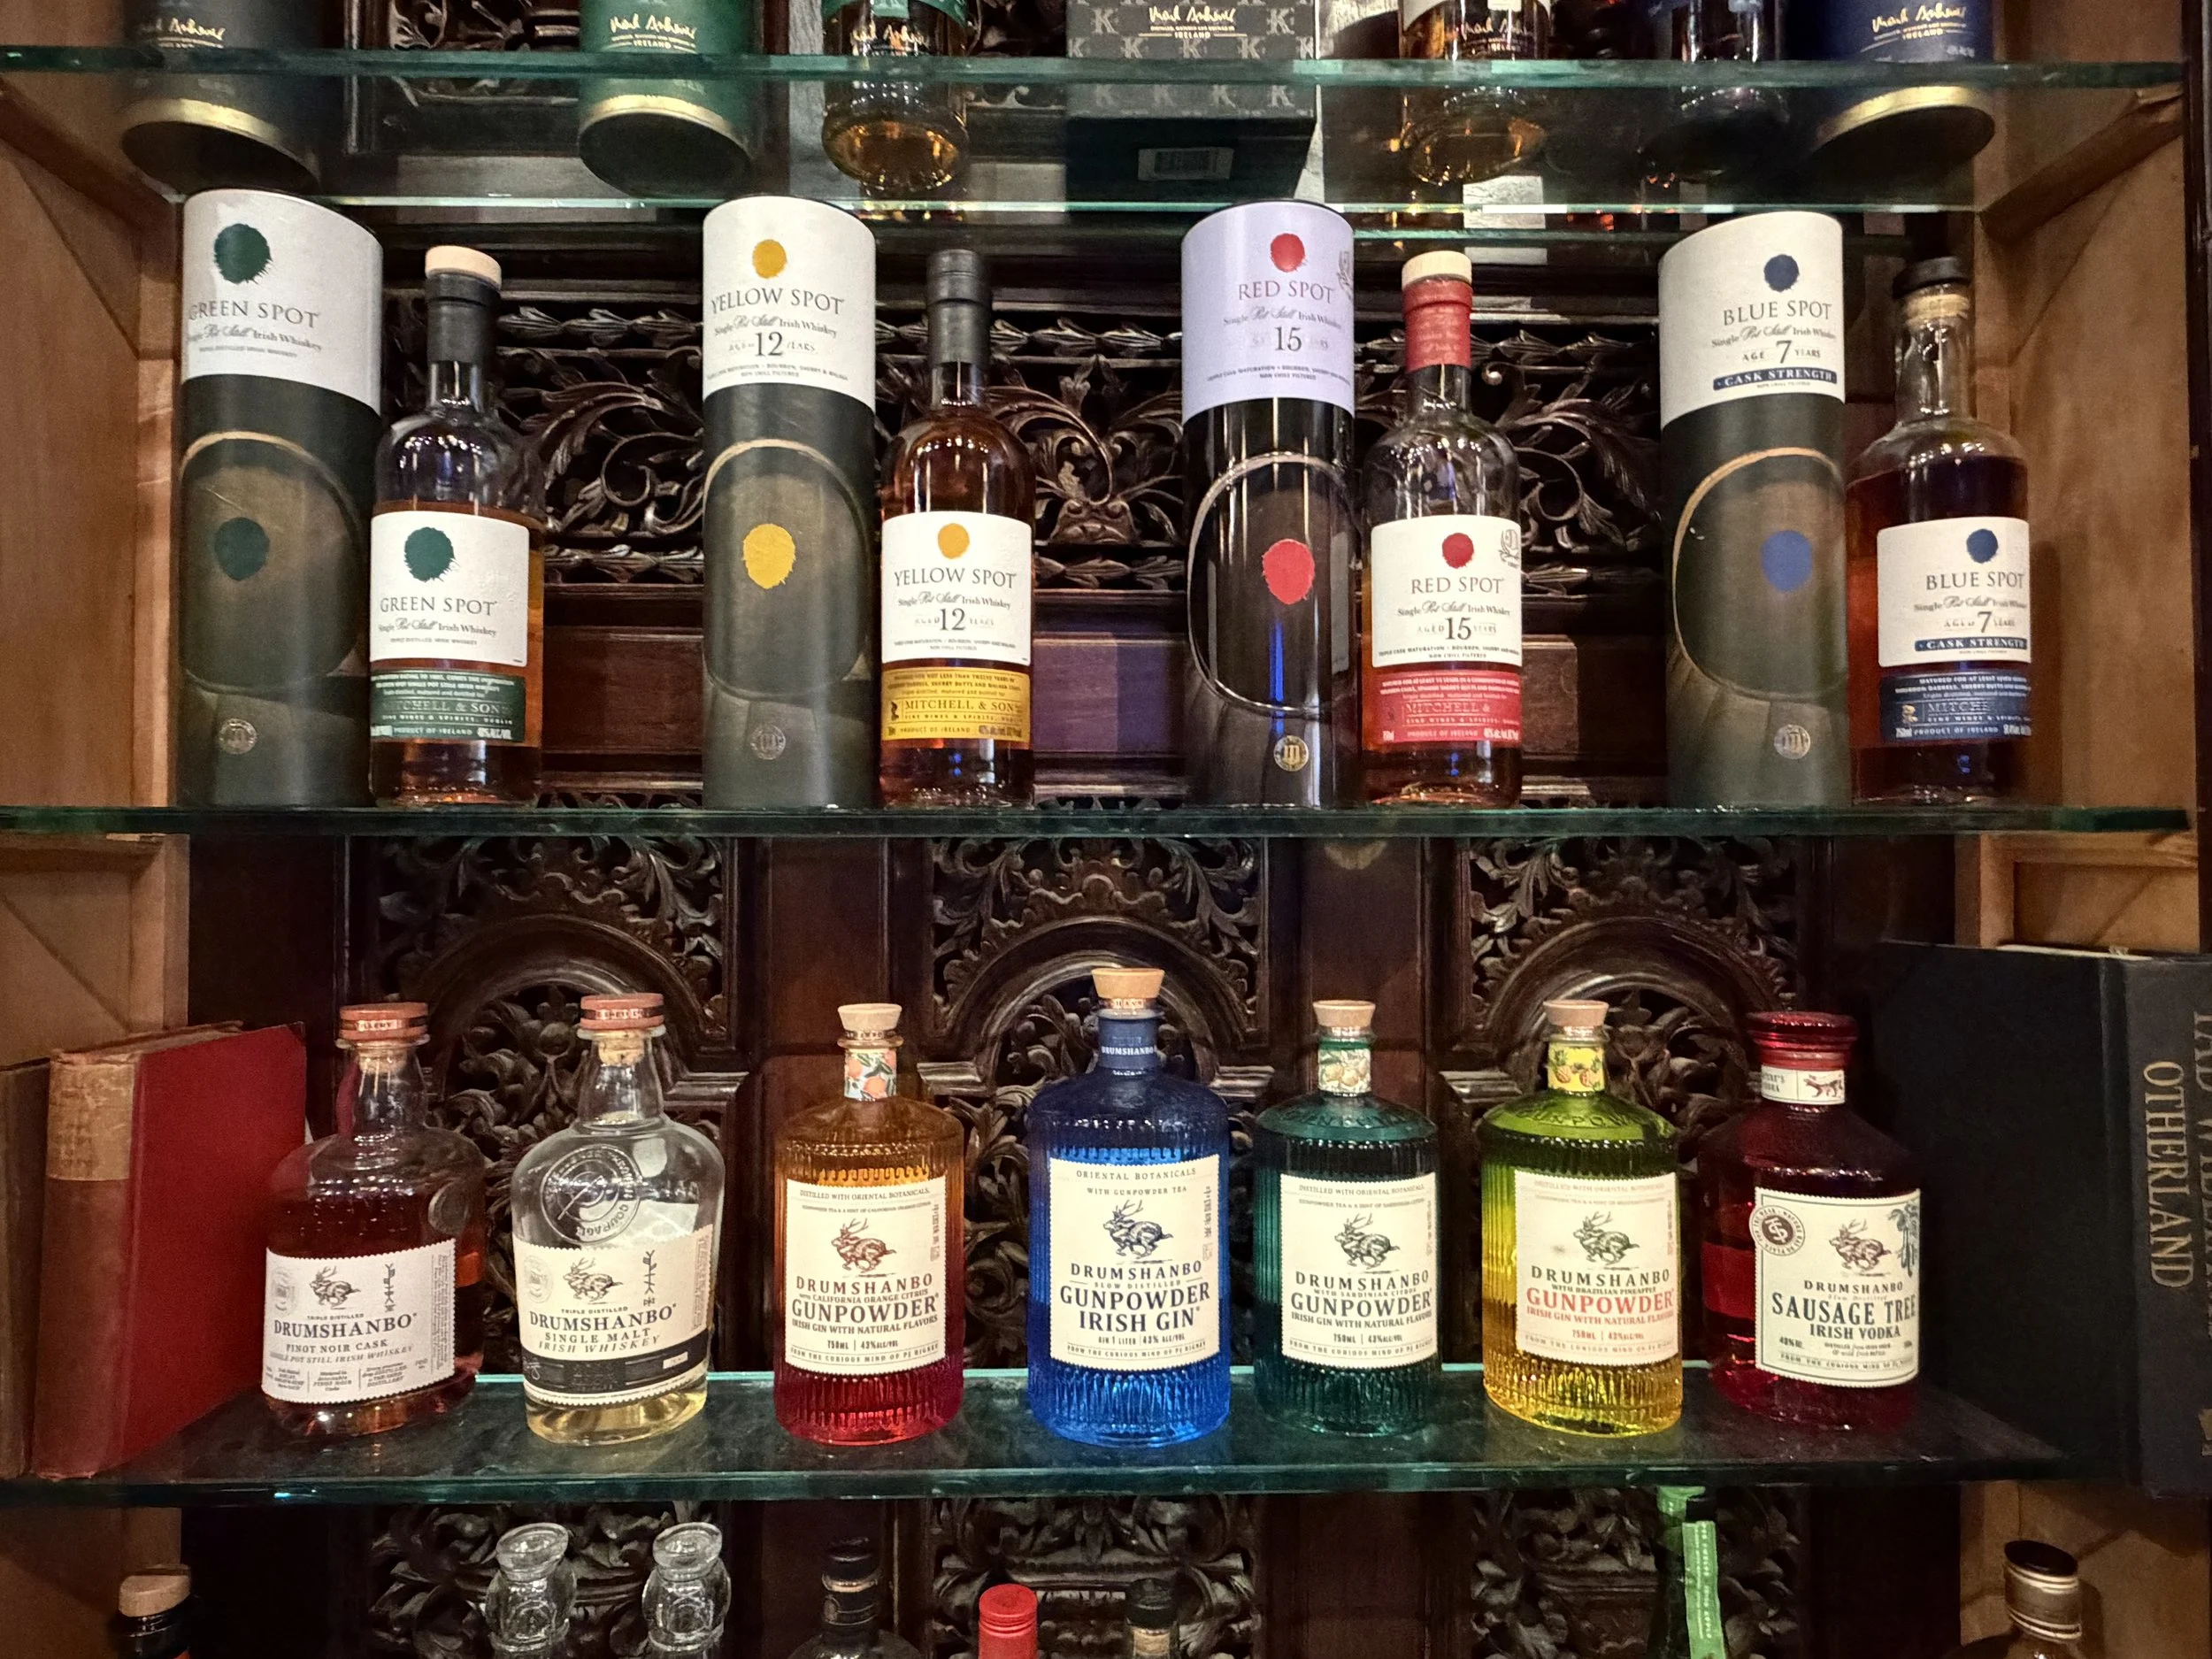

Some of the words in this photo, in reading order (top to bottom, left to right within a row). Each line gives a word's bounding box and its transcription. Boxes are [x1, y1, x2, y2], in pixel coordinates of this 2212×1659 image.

[1902, 28, 1943, 40] IRELAND
[633, 40, 672, 49] IRELAND
[1240, 280, 1280, 300] RED
[1288, 280, 1334, 303] SPOT
[711, 288, 783, 314] YELLOW
[790, 288, 844, 314] SPOT
[188, 301, 248, 320] GREEN
[257, 302, 319, 328] SPOT
[1724, 301, 1778, 326] BLUE
[1786, 300, 1832, 319] SPOT
[779, 319, 800, 328] Irish
[802, 320, 837, 339] Whiskey
[254, 331, 278, 342] Irish
[279, 333, 321, 350] Whiskey
[755, 332, 783, 357] 12
[1275, 326, 1302, 352] 15
[1711, 334, 1740, 348] Single
[1776, 340, 1792, 364] 7
[1794, 349, 1821, 358] YEARS
[1724, 371, 1763, 387] CASK
[1769, 369, 1832, 381] STRENGTH
[894, 567, 965, 587] YELLOW
[972, 568, 1017, 589] SPOT
[1411, 577, 1451, 595] RED
[1458, 577, 1502, 594] SPOT
[1926, 572, 1979, 590] BLUE
[1986, 572, 2025, 589] SPOT
[380, 596, 435, 613] GREEN
[443, 597, 495, 616] SPOT
[898, 598, 917, 607] Single
[982, 597, 1010, 611] Whiskey
[1397, 607, 1421, 617] Single
[1914, 603, 1943, 612] Single
[940, 608, 966, 631] 12
[1978, 611, 1992, 634] 7
[438, 623, 459, 632] Irish
[461, 625, 497, 636] Whiskey
[1417, 625, 1444, 634] AGED
[1445, 617, 1471, 640] 15
[1472, 625, 1496, 634] YEARS
[1926, 640, 1963, 649] CASK
[1970, 638, 2024, 649] STRENGTH
[455, 703, 467, 712] &
[904, 700, 974, 710] MITCHELL
[978, 701, 987, 710] &
[1406, 702, 1480, 712] MITCHELL
[1076, 1170, 1129, 1180] ORIENTAL
[1134, 1167, 1196, 1180] BOTANICALS
[2143, 1061, 2194, 1287] OTHERLAND
[800, 1189, 829, 1200] DISTILLED
[1114, 1187, 1168, 1195] GUNPOWDER
[1299, 1184, 1333, 1194] DISTILLED
[1071, 1260, 1202, 1280] DRUMSHANBO
[1532, 1265, 1670, 1287] DRUMSHANBO
[796, 1273, 933, 1294] DRUMSHANBO
[1127, 1279, 1180, 1289] DISTILLED
[1295, 1270, 1429, 1290] DRUMSHANBO
[1804, 1279, 1903, 1294] DRUMSHANBO
[813, 1294, 862, 1304] CALIFORNIA
[864, 1294, 900, 1303] ORANGE
[901, 1288, 928, 1299] CITRUS
[1060, 1282, 1210, 1310] GUNPOWDER
[1391, 1287, 1417, 1296] CITRUS
[1526, 1306, 1553, 1319] IRISH
[1554, 1311, 1571, 1322] GIN
[1574, 1315, 1601, 1325] WITH
[1604, 1313, 1646, 1325] NATURAL
[1771, 1293, 1874, 1325] SAUSAGE
[1884, 1294, 1916, 1324] TREE
[273, 1314, 412, 1339] DRUMSHANBO
[529, 1306, 672, 1332] DRUMSHANBO
[792, 1318, 810, 1330] IRISH
[812, 1324, 827, 1333] GIN
[830, 1325, 855, 1334] WITH
[857, 1323, 902, 1334] NATURAL
[903, 1314, 939, 1330] FLAVORS
[1079, 1310, 1146, 1333] IRISH
[1156, 1307, 1195, 1331] GIN
[1291, 1311, 1314, 1324] IRISH
[1317, 1316, 1333, 1326] GIN
[1335, 1318, 1362, 1328] WITH
[1364, 1317, 1404, 1328] NATURAL
[544, 1333, 599, 1344] SINGLE
[607, 1328, 651, 1341] MALT
[1143, 1335, 1159, 1344] 43%
[1333, 1333, 1356, 1343] 750ML
[1809, 1324, 1854, 1340] IRISH
[1859, 1325, 1901, 1340] VODKA
[286, 1343, 316, 1354] PINOT
[320, 1344, 350, 1353] NOIR
[356, 1339, 388, 1351] CASK
[538, 1340, 576, 1353] IRISH
[585, 1335, 660, 1353] WHISKEY
[1067, 1345, 1085, 1354] FROM
[1312, 1343, 1327, 1354] THE
[1332, 1348, 1368, 1356] CURIOUS
[335, 1355, 364, 1363] IRISH
[367, 1347, 413, 1360] WHISKEY
[809, 1352, 822, 1361] THE
[825, 1355, 861, 1363] CURIOUS
[1780, 1353, 1801, 1363] FROM
